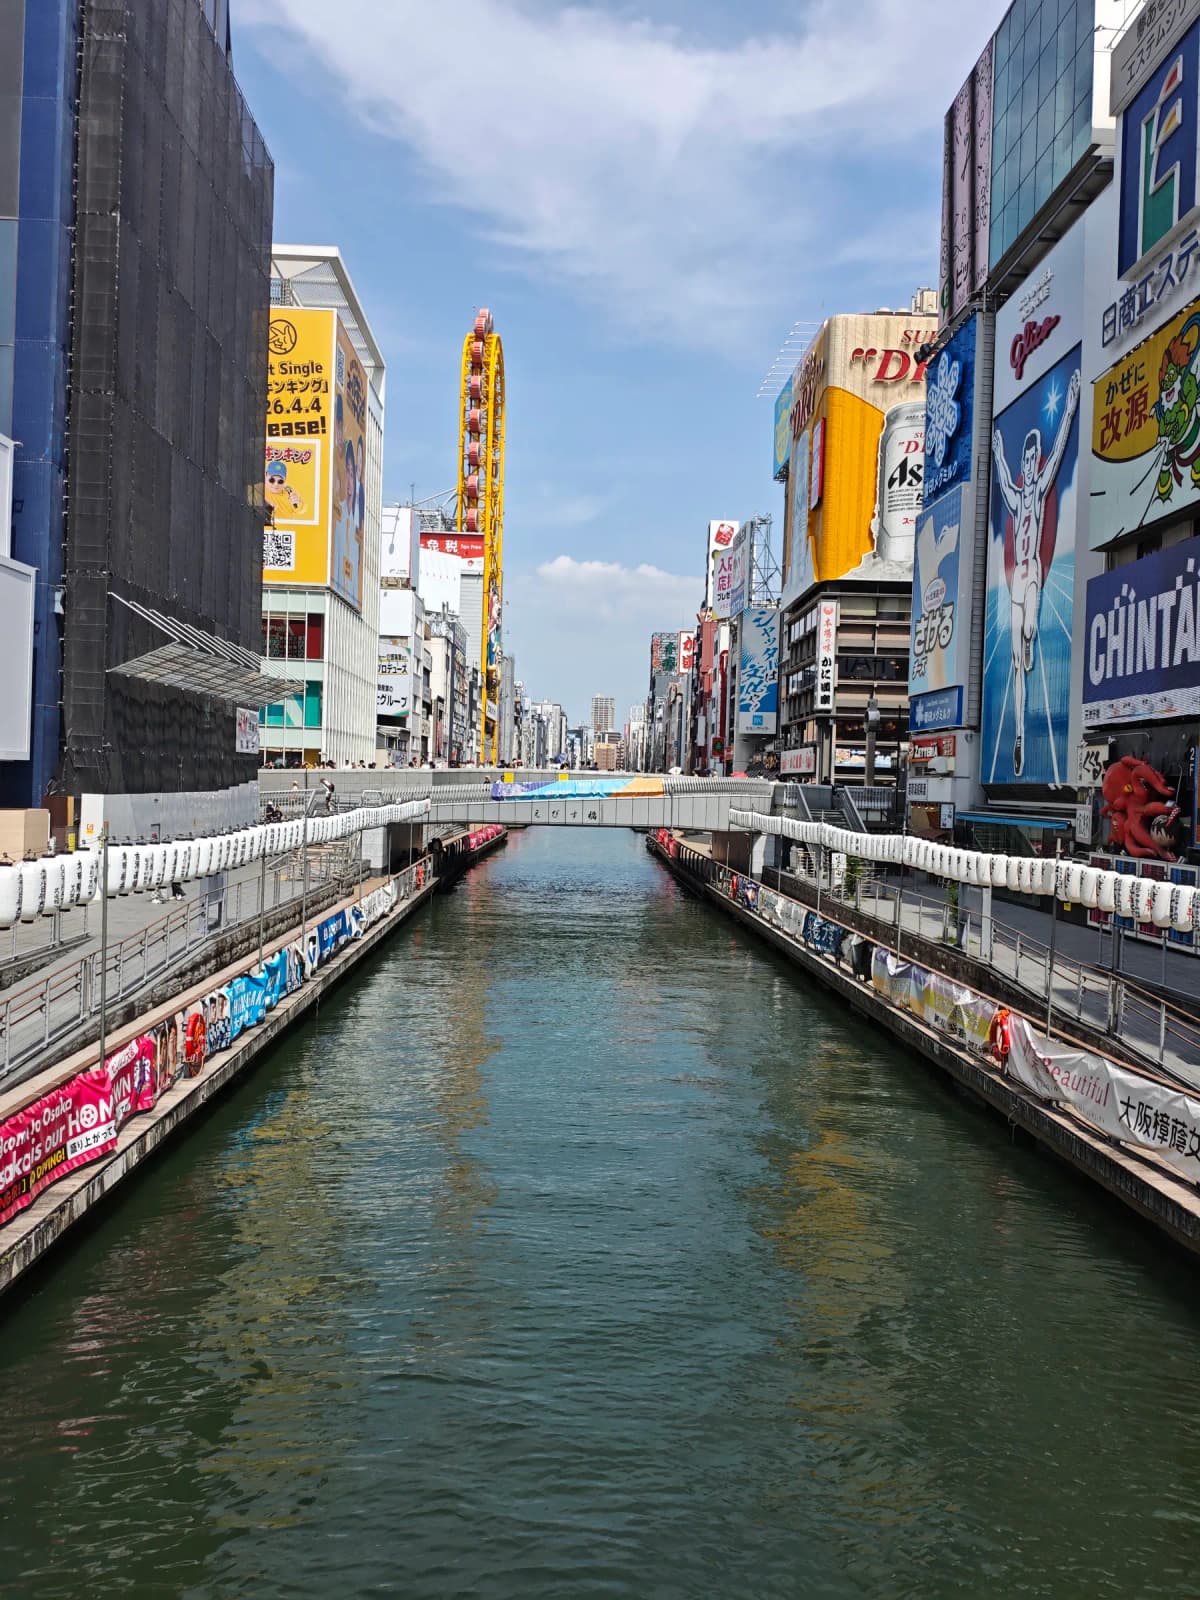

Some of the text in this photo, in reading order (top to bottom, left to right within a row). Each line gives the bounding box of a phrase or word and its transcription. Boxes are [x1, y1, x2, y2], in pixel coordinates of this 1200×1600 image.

[1102, 229, 1200, 348] 日商エステ
[280, 361, 323, 378] Single
[1010, 315, 1061, 380] Glico
[1105, 361, 1146, 405] かぜに
[1100, 383, 1149, 452] 改源
[1021, 511, 1031, 580] グリコ
[914, 601, 954, 657] さける
[1089, 581, 1200, 686] CHINTA
[42, 1097, 72, 1127] Osaka
[44, 1125, 66, 1153] our
